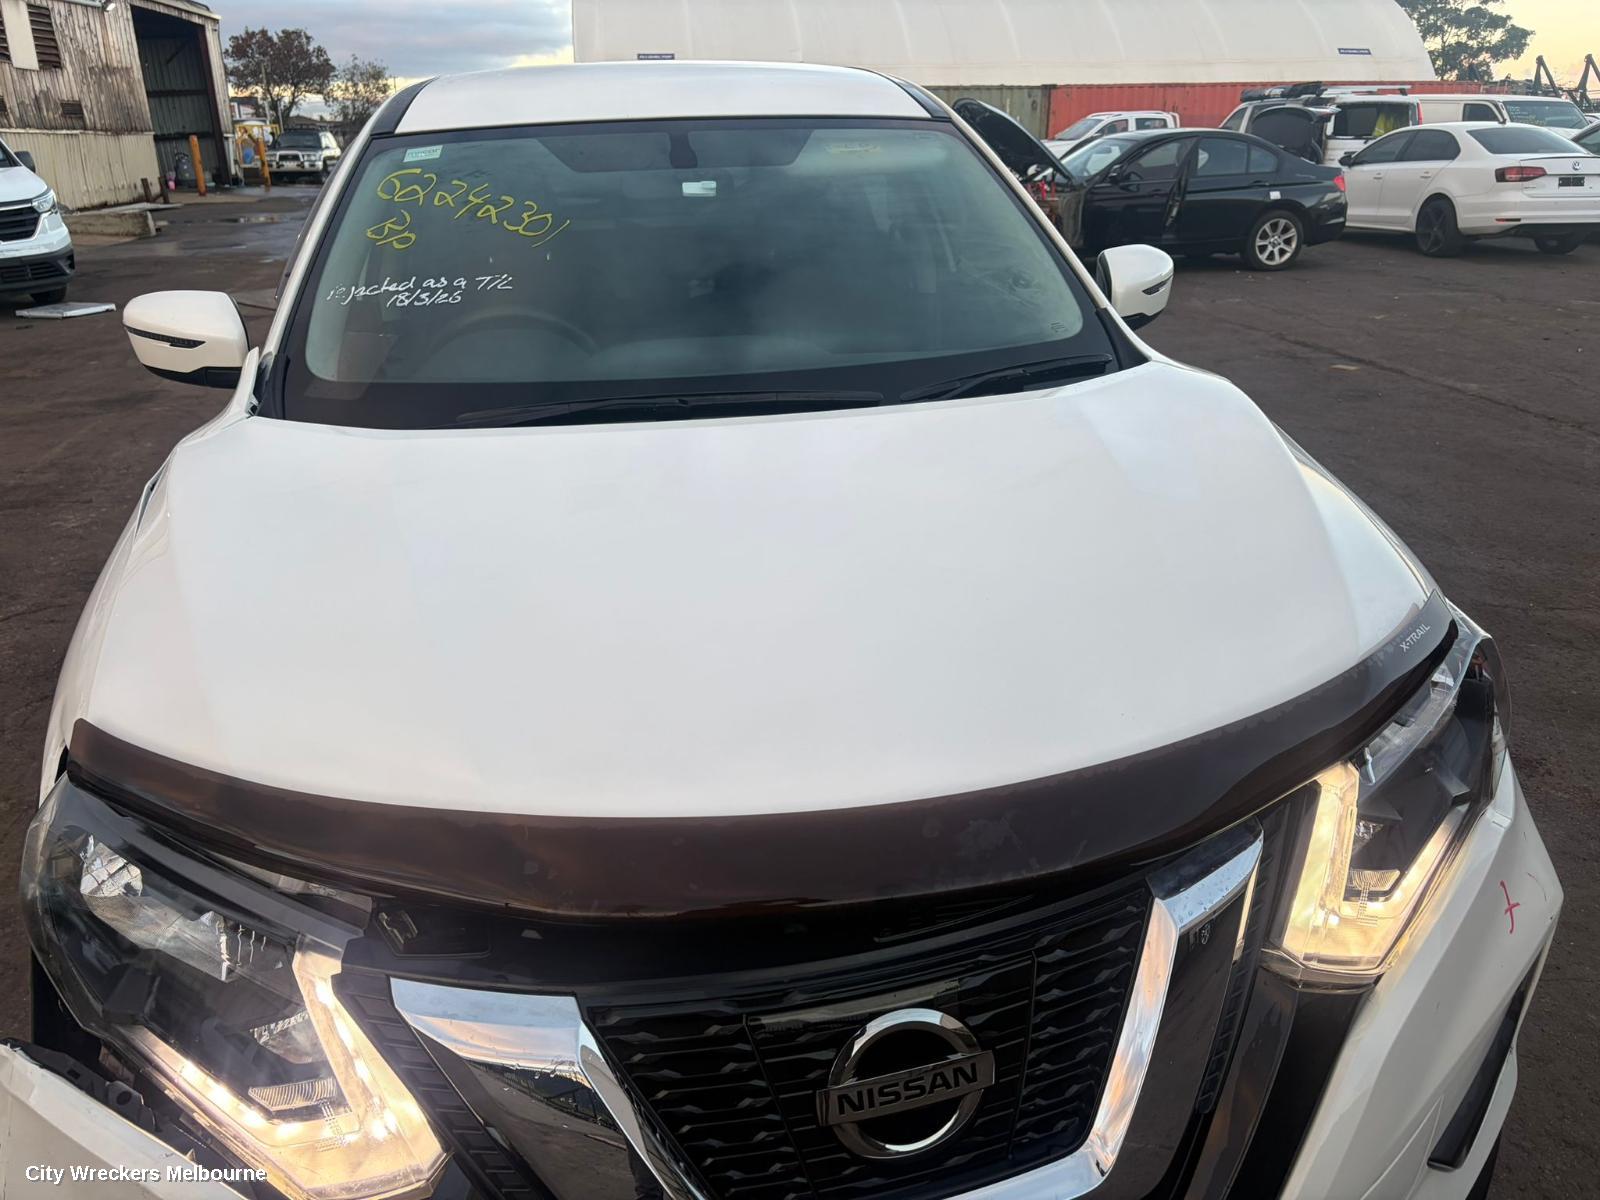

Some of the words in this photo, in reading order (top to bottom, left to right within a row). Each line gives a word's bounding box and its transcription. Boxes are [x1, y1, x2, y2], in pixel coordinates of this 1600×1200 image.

[422, 277, 448, 288] as
[453, 277, 467, 289] a
[1399, 623, 1431, 652] X-TRAIL
[837, 1062, 978, 1115] NISSAN
